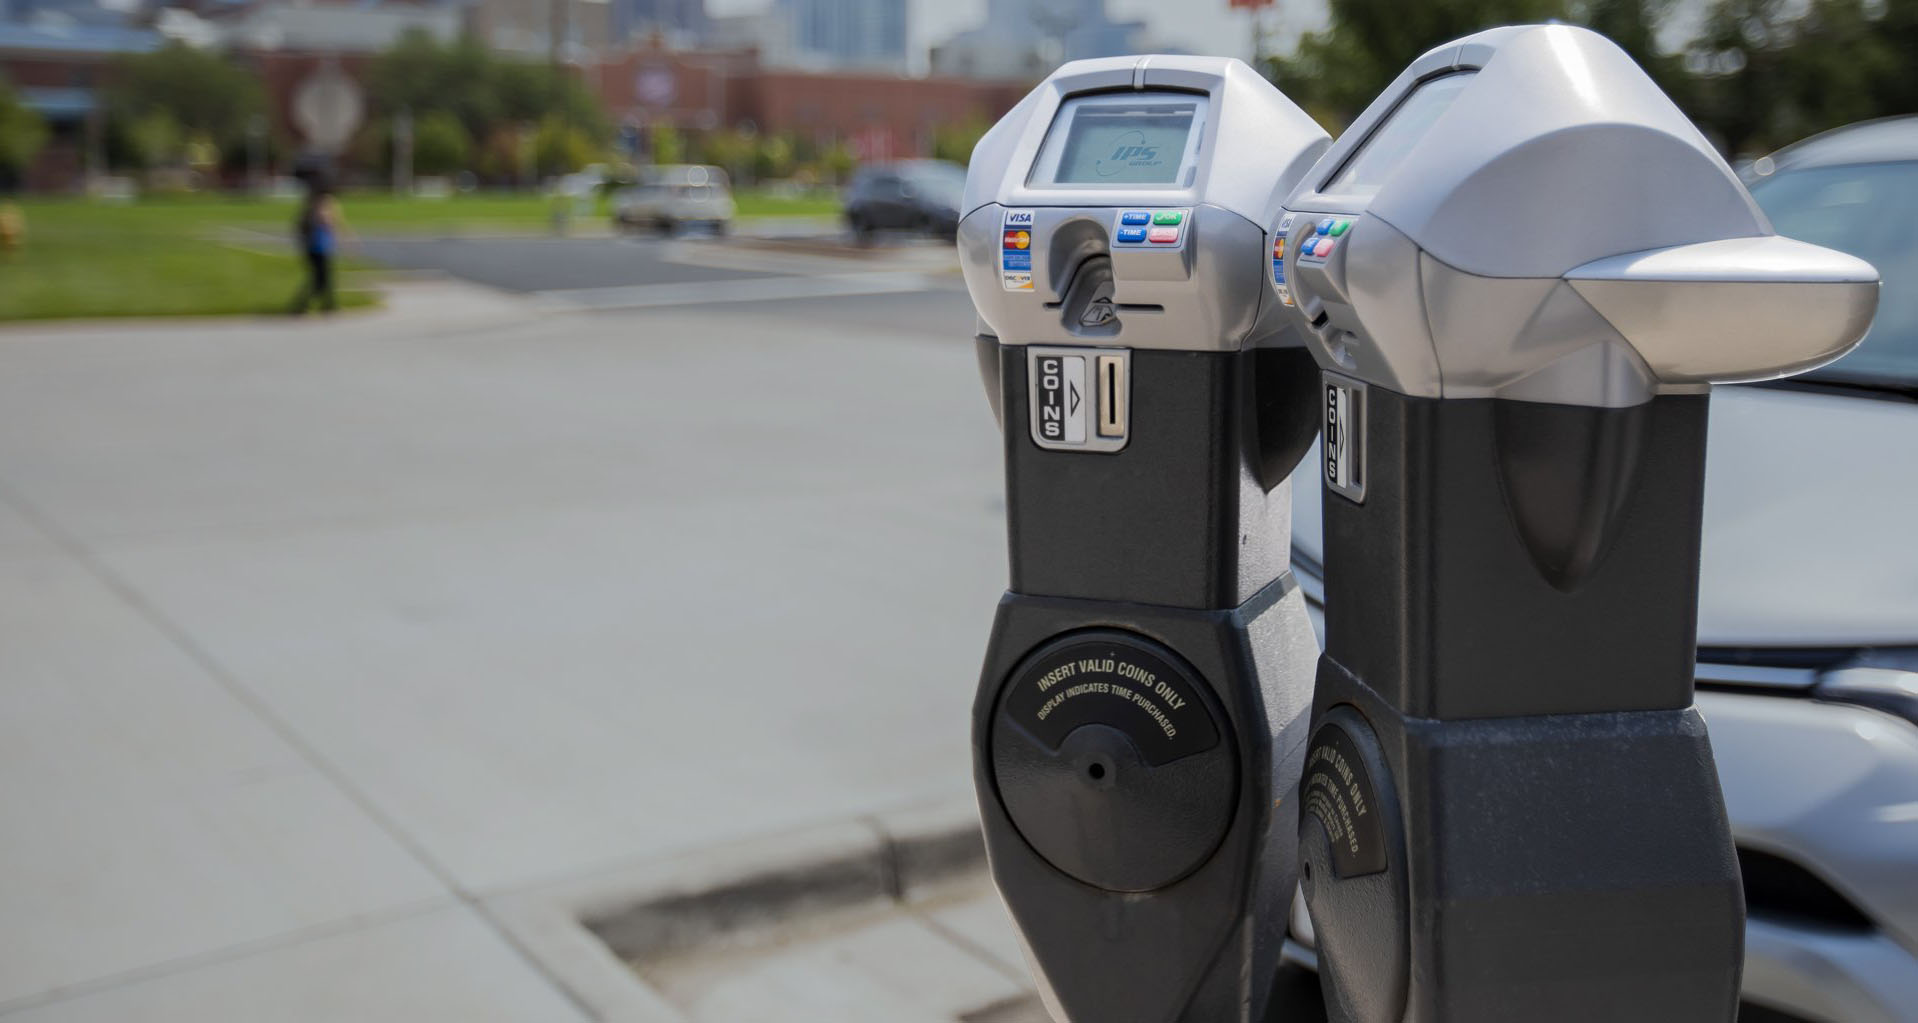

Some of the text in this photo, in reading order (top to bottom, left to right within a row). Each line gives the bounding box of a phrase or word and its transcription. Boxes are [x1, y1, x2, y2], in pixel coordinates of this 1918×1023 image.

[1111, 146, 1159, 160] IPS
[1010, 213, 1031, 222] VISA
[1043, 360, 1060, 436] COINS
[1328, 389, 1336, 478] COINS
[1037, 659, 1186, 710] INSERT VALID COINS ONLY
[1037, 683, 1177, 740] DISPLAY INDICATES TIME PURCHASED.
[1327, 778, 1339, 799] TIME
[1335, 754, 1354, 786] COINS
[1350, 783, 1367, 816] ONLY
